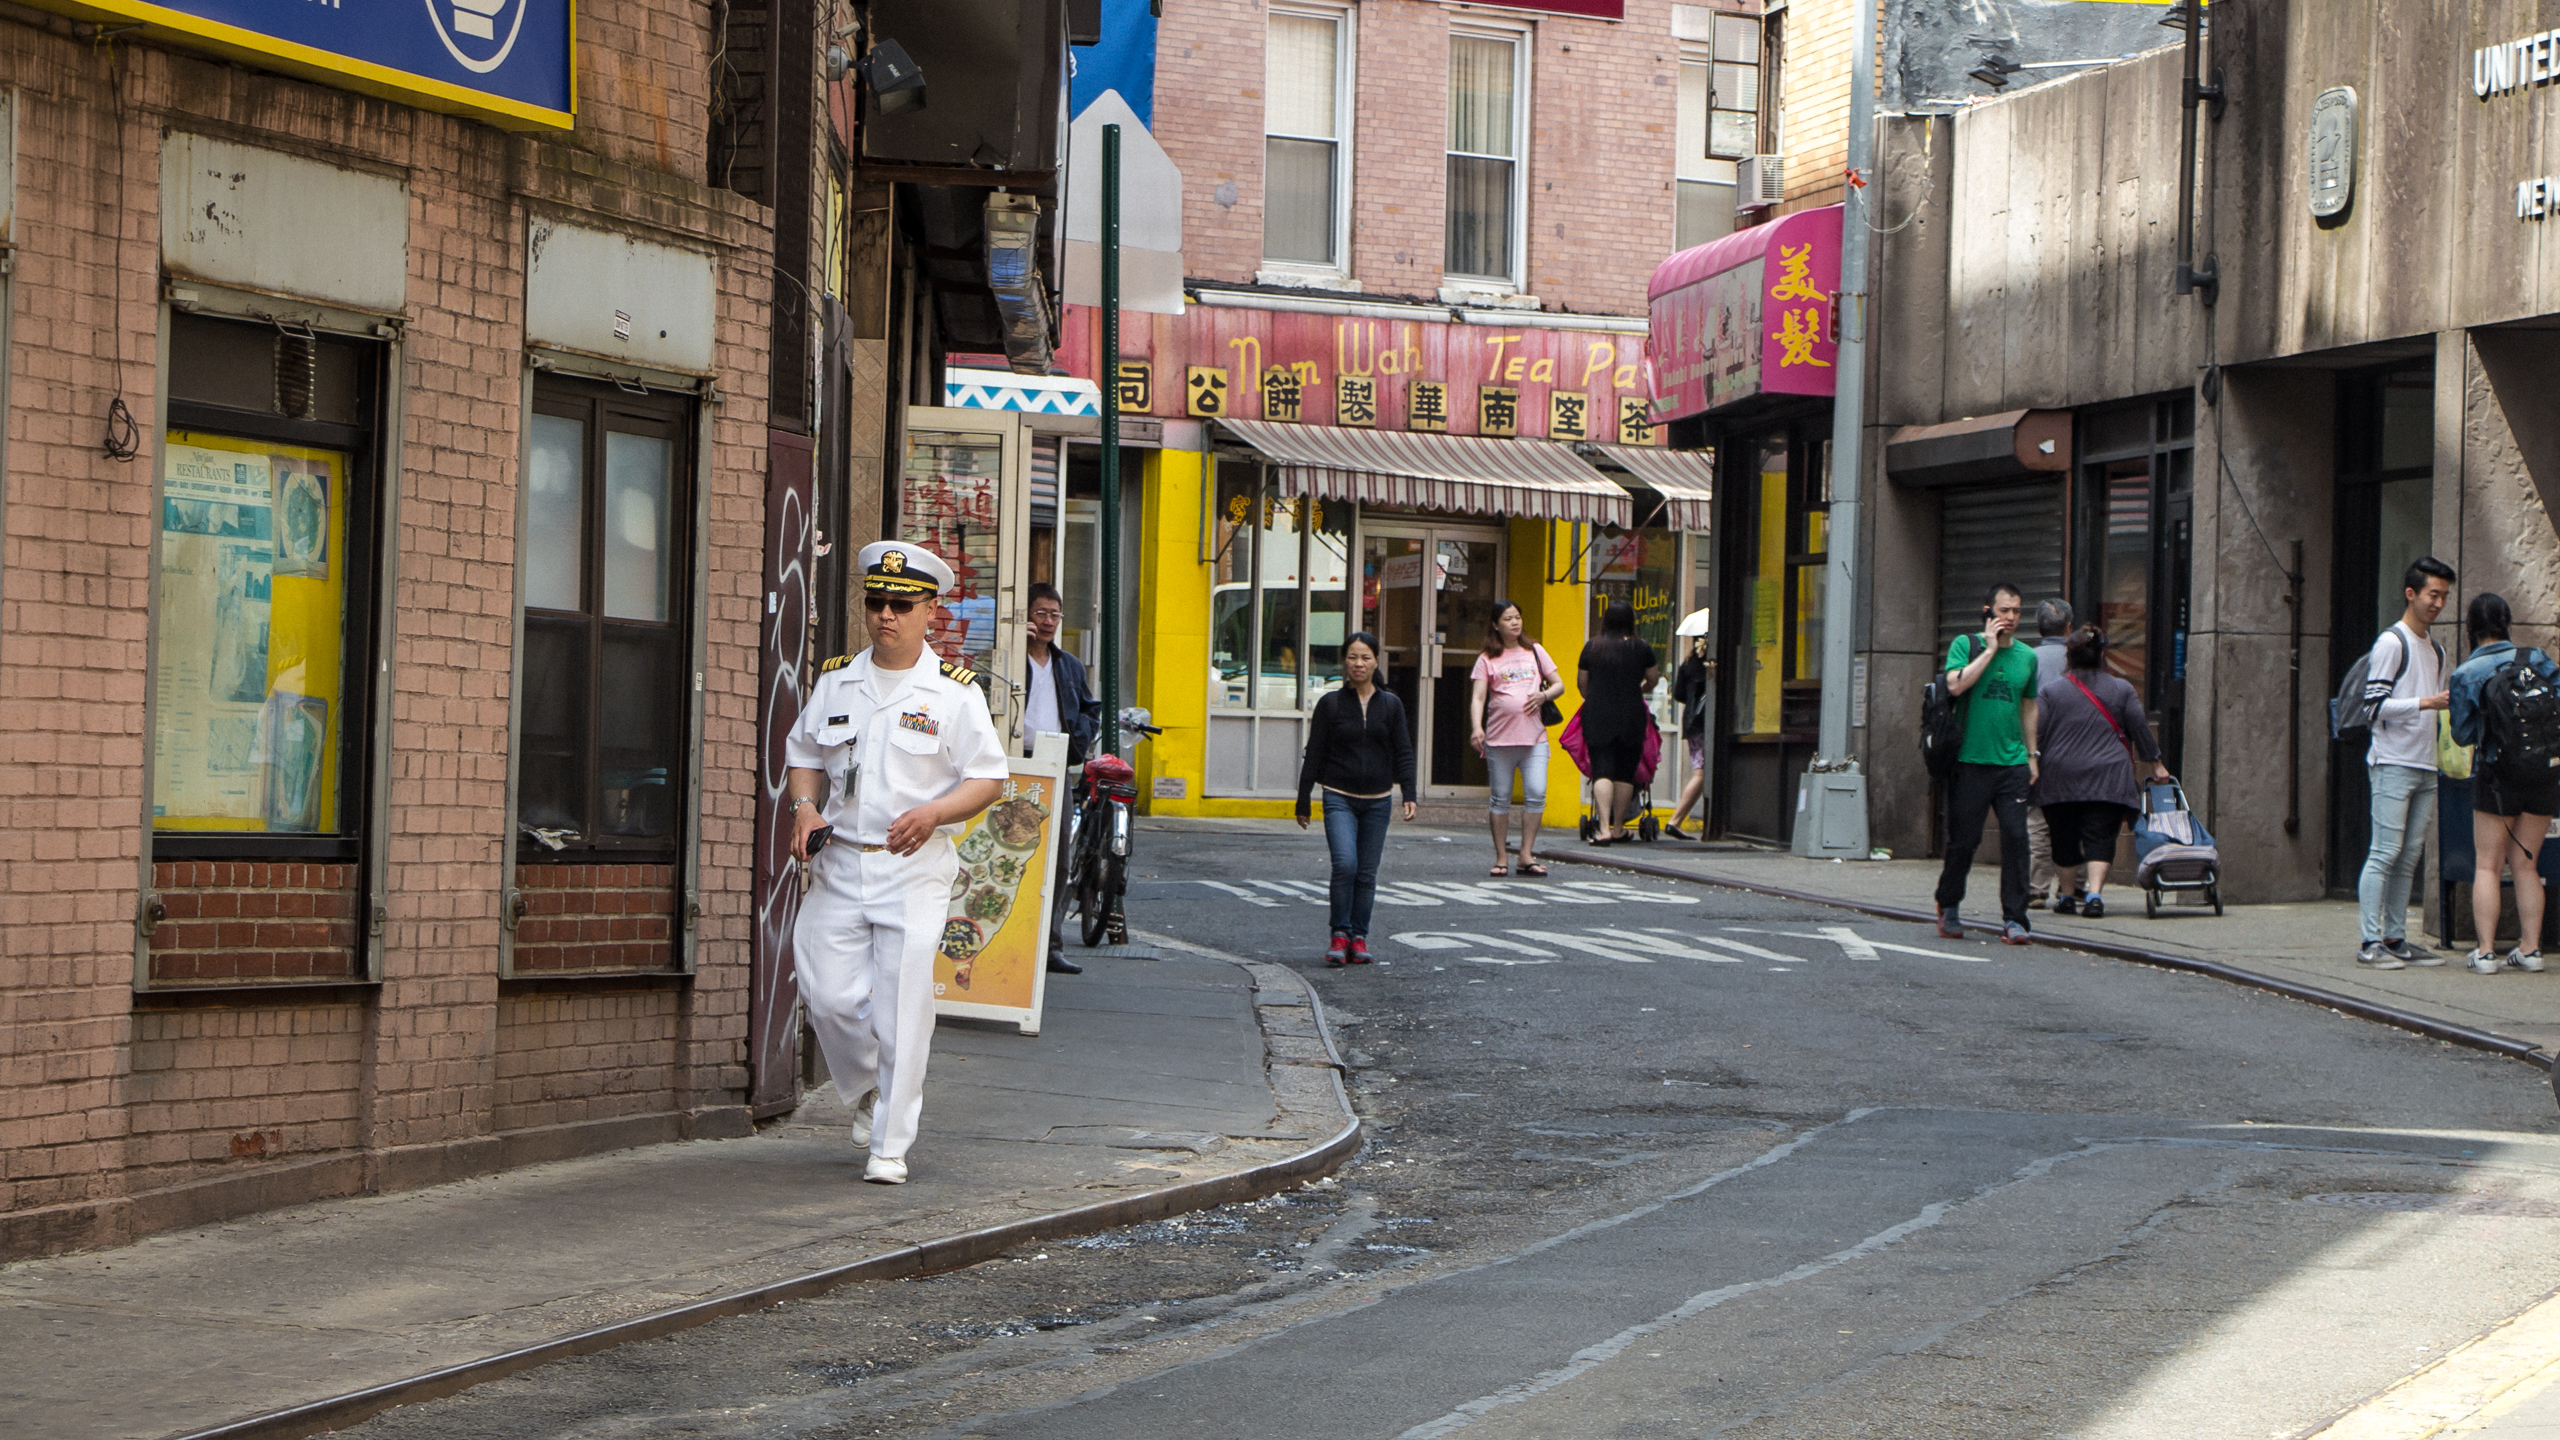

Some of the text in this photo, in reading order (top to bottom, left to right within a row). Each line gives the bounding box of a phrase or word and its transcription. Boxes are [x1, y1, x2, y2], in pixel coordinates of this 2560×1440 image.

[2474, 28, 2560, 96] UNITED
[1229, 336, 1321, 395] Nm
[1337, 321, 1424, 377] Wah
[1486, 335, 1554, 383] Tea
[1581, 342, 1648, 389] Pa
[176, 463, 231, 482] RESTAURANTS
[1633, 585, 1668, 610] Wah
